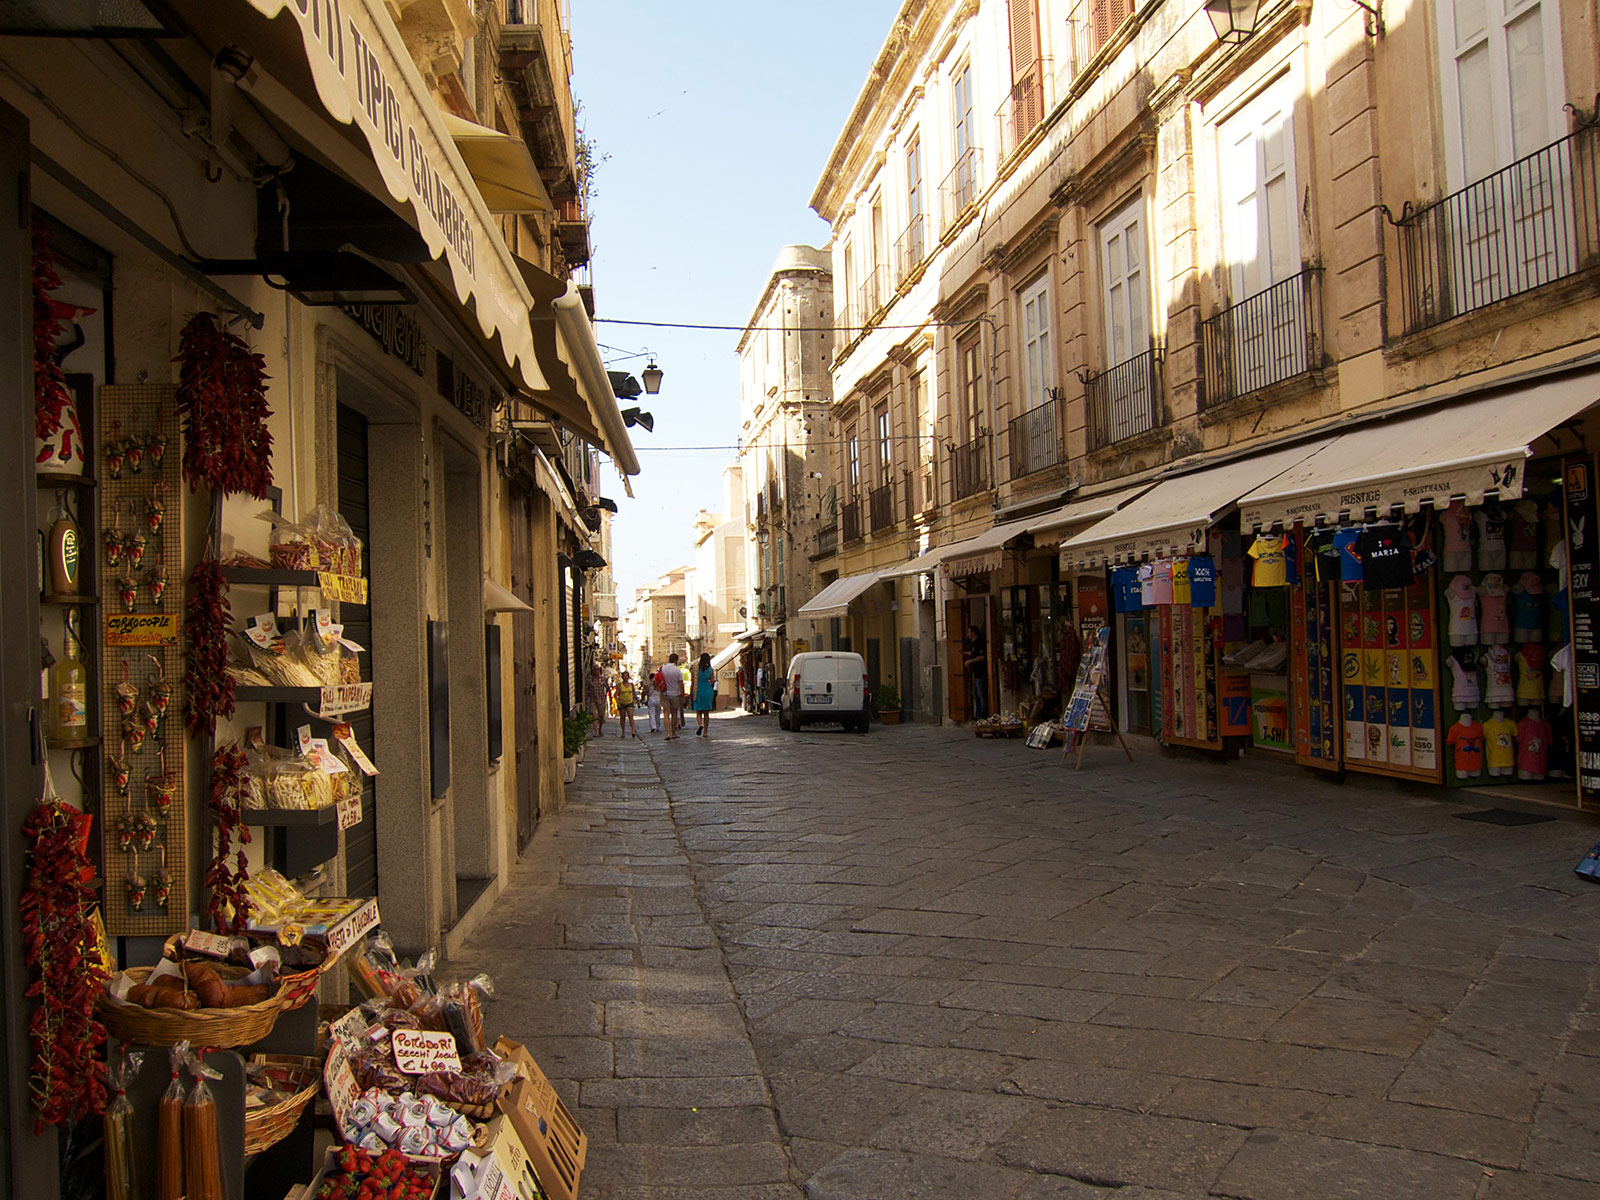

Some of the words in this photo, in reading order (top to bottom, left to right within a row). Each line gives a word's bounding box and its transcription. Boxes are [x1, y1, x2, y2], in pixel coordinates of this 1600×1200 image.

[349, 16, 406, 173] TIPICI
[409, 126, 477, 281] CALABRESI
[1403, 482, 1450, 496] T-SHIRTMANIA
[1340, 490, 1380, 506] PRESTIGE
[1371, 548, 1400, 558] MARIA
